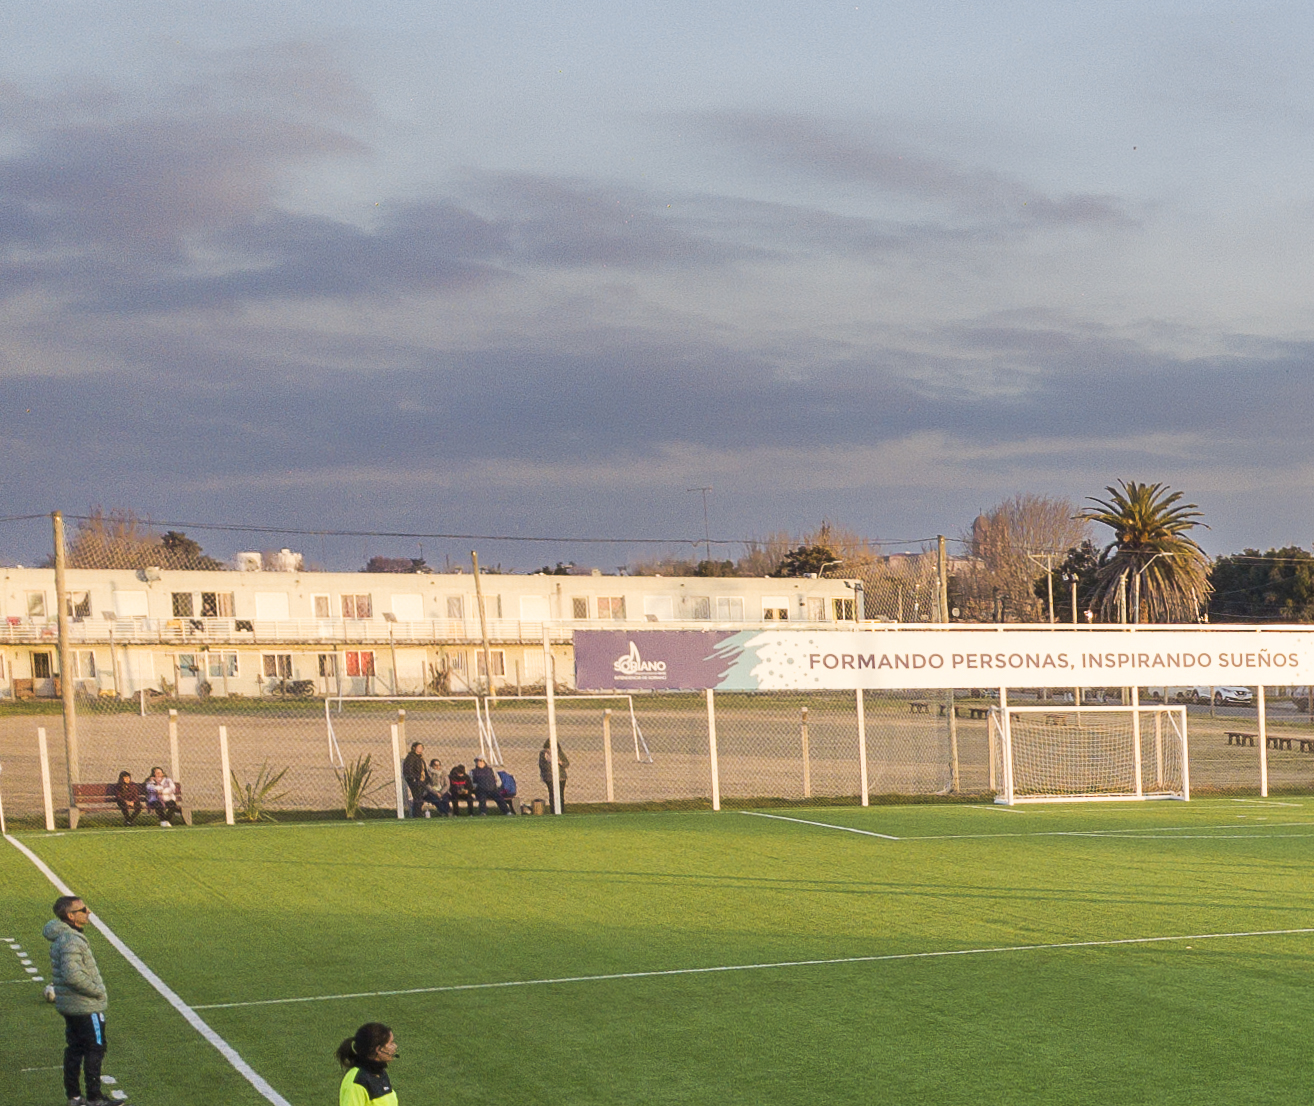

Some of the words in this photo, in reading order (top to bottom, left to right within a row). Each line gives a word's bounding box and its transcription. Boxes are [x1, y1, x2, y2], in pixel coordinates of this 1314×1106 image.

[614, 660, 666, 674] SORIANO
[809, 653, 944, 669] FORMANDO
[952, 653, 1075, 670] PERSONAS,
[1082, 653, 1212, 668] INSPIRANDO
[1218, 648, 1299, 668] SUEÑOS
